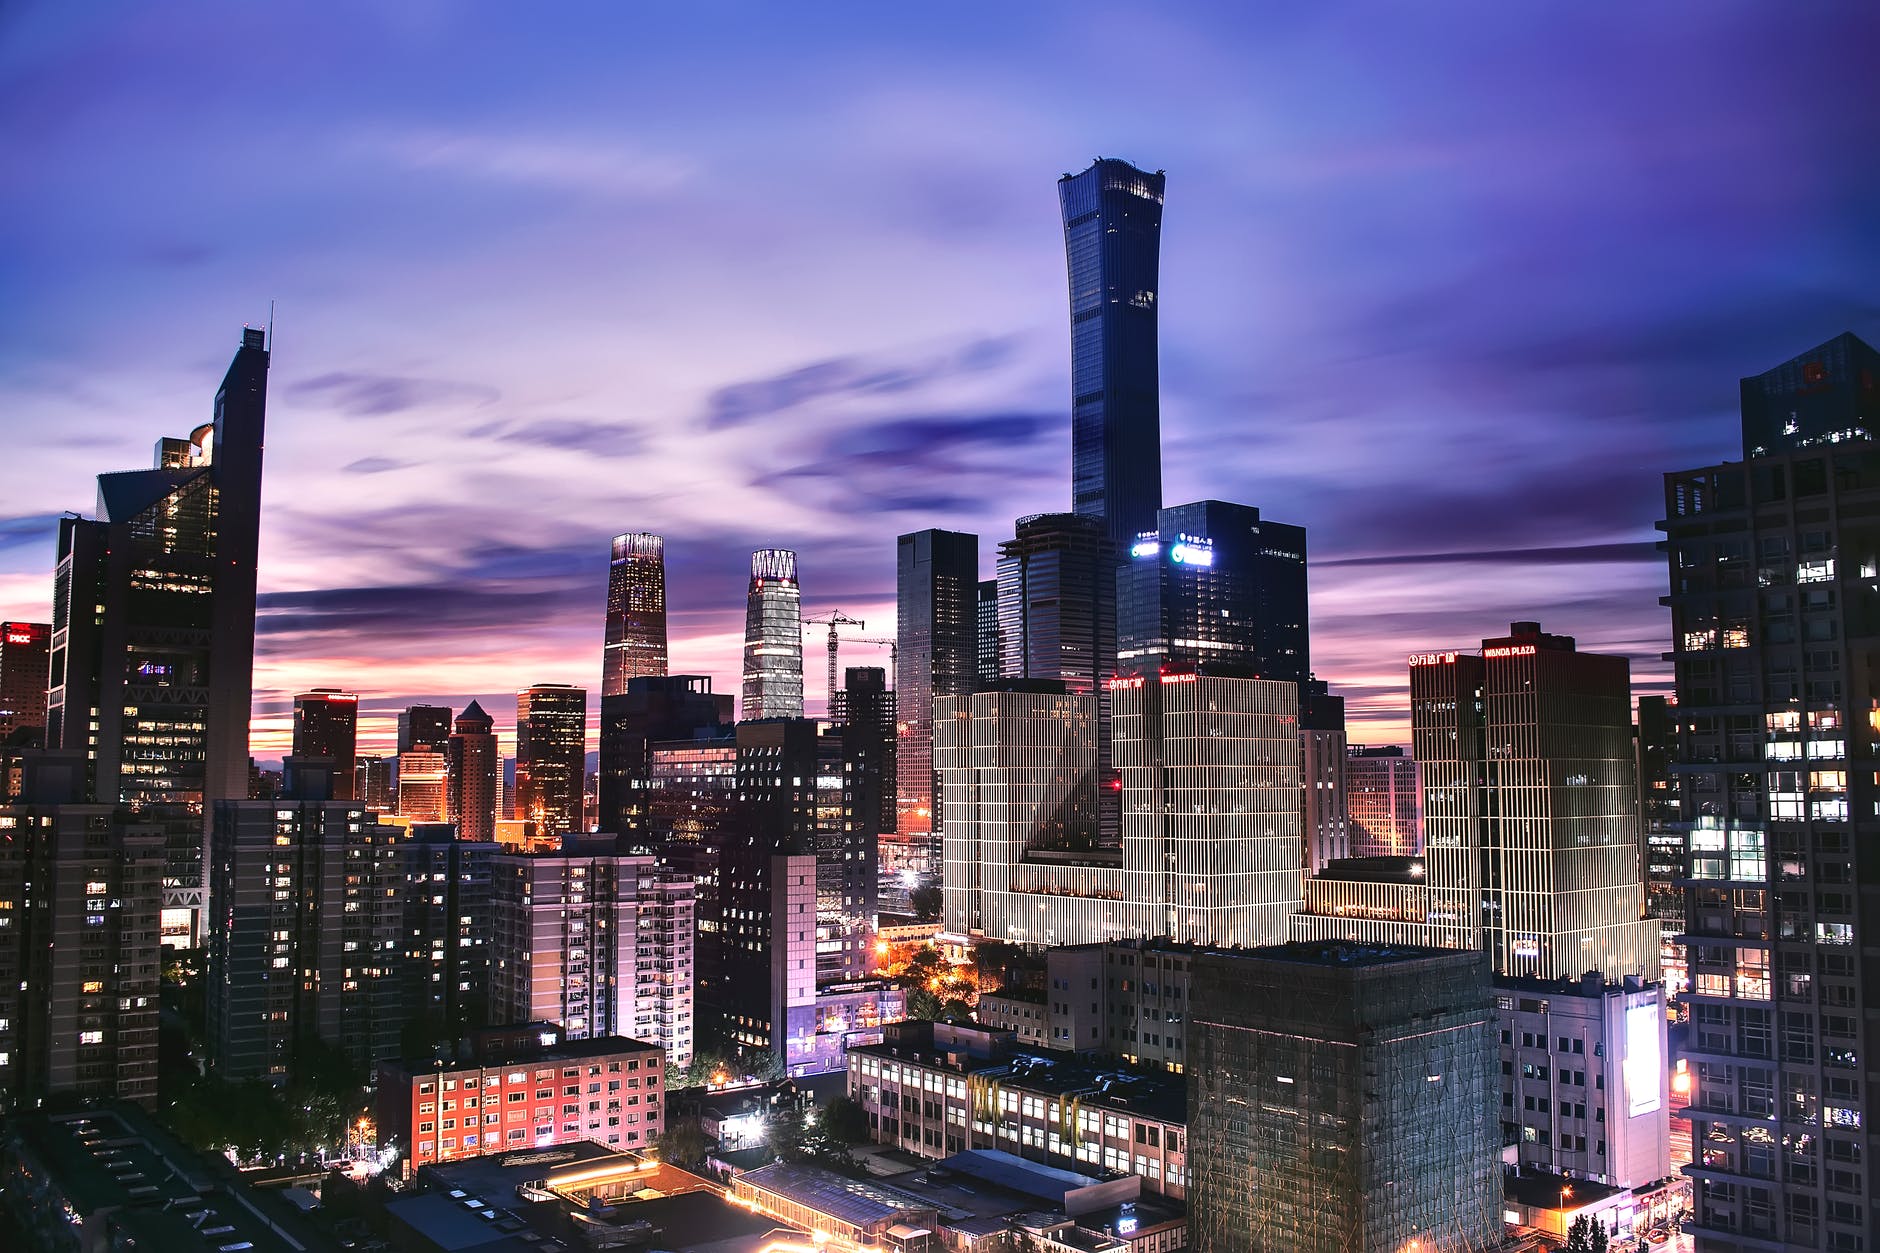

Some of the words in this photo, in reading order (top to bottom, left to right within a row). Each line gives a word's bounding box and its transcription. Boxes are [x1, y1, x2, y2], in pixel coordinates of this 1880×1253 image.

[9, 635, 31, 643] PICC
[1485, 647, 1510, 657] WANDA
[1511, 646, 1535, 656] PLAZA
[1161, 675, 1179, 683] WANDA
[1179, 673, 1196, 682] PLAZA
